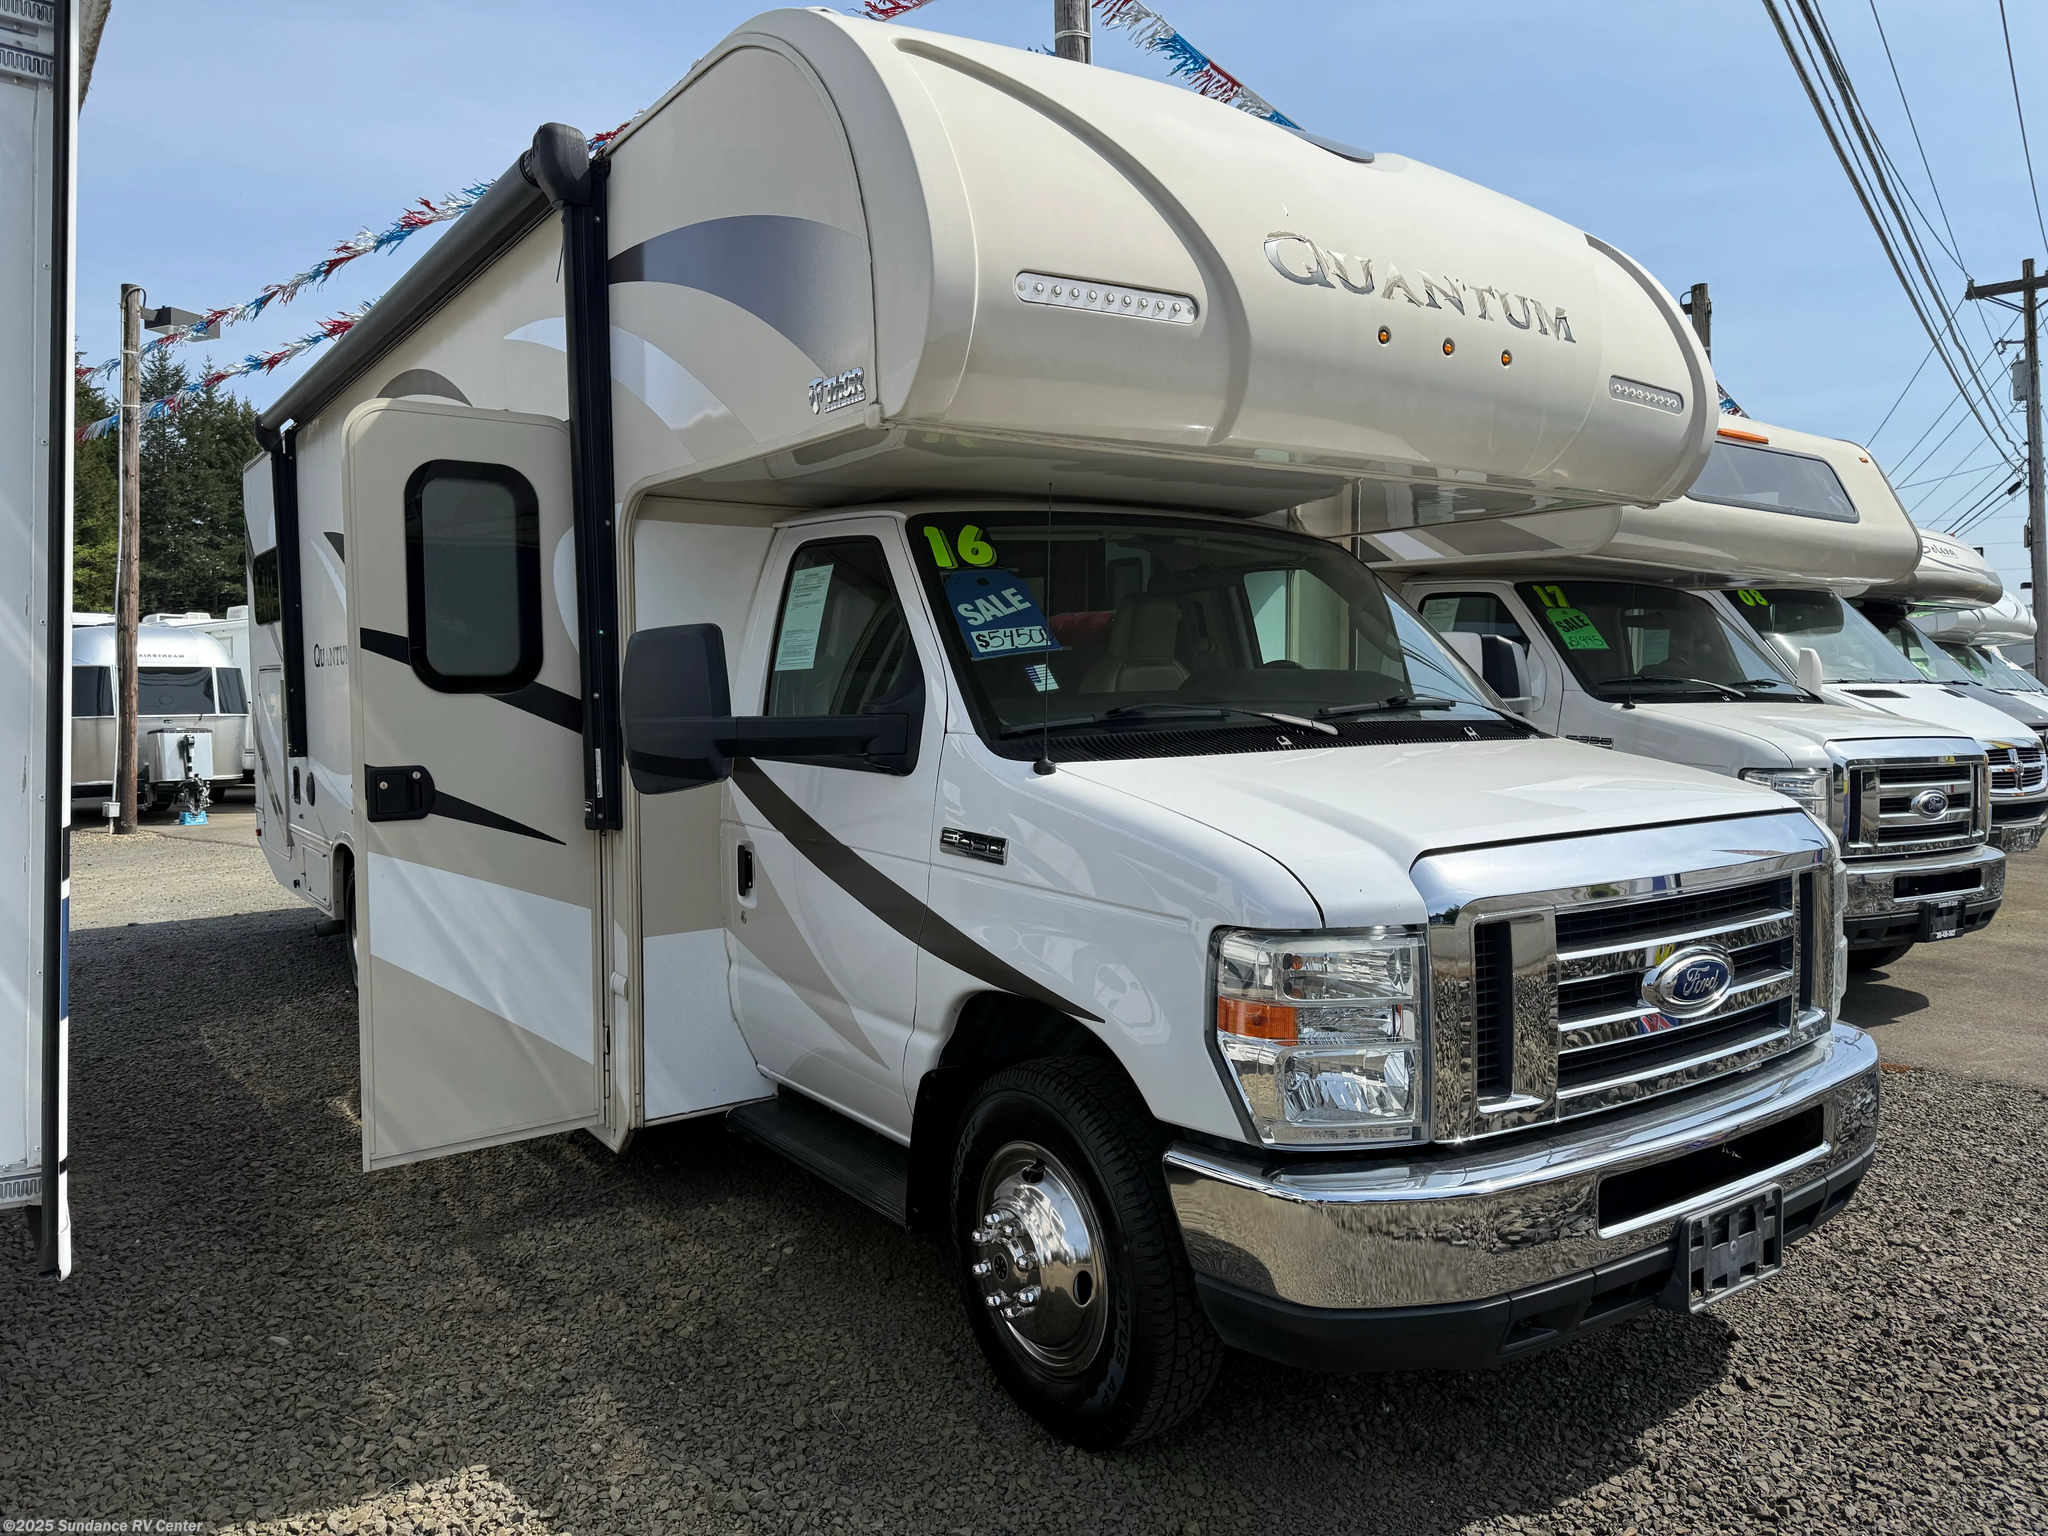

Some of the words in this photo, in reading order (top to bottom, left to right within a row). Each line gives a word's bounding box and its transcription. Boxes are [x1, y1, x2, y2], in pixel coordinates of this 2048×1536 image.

[1264, 231, 1576, 343] QUANTUM
[823, 367, 865, 403] THOR
[923, 524, 997, 568] 16
[957, 587, 1032, 626] SALE
[1532, 585, 1570, 608] 17
[1737, 589, 1769, 606] 08
[1555, 614, 1591, 633] SALE
[1682, 965, 1720, 997] Ford
